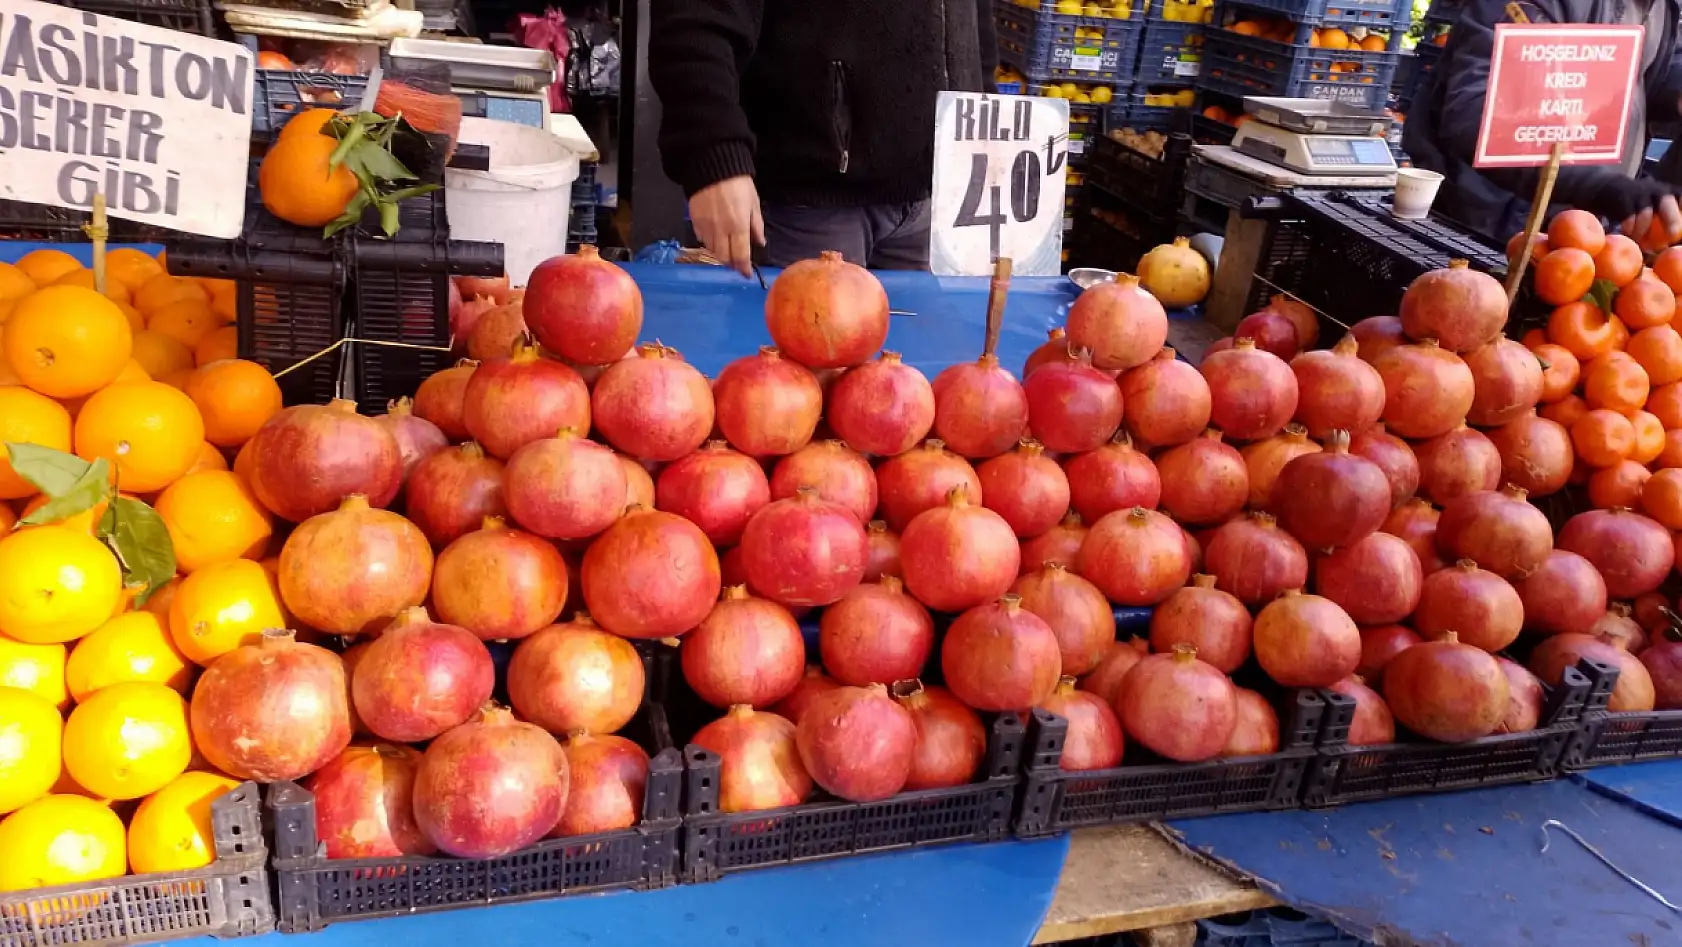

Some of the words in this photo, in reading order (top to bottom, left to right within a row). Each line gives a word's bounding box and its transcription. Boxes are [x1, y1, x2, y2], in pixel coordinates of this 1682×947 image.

[0, 11, 249, 115] AŞİKTON
[1543, 71, 1588, 88] KREDİ
[955, 93, 1033, 141] KİLO
[1539, 98, 1585, 117] KARTI
[1514, 124, 1598, 147] GEÇERLİDİR
[57, 159, 181, 216] GİBİ
